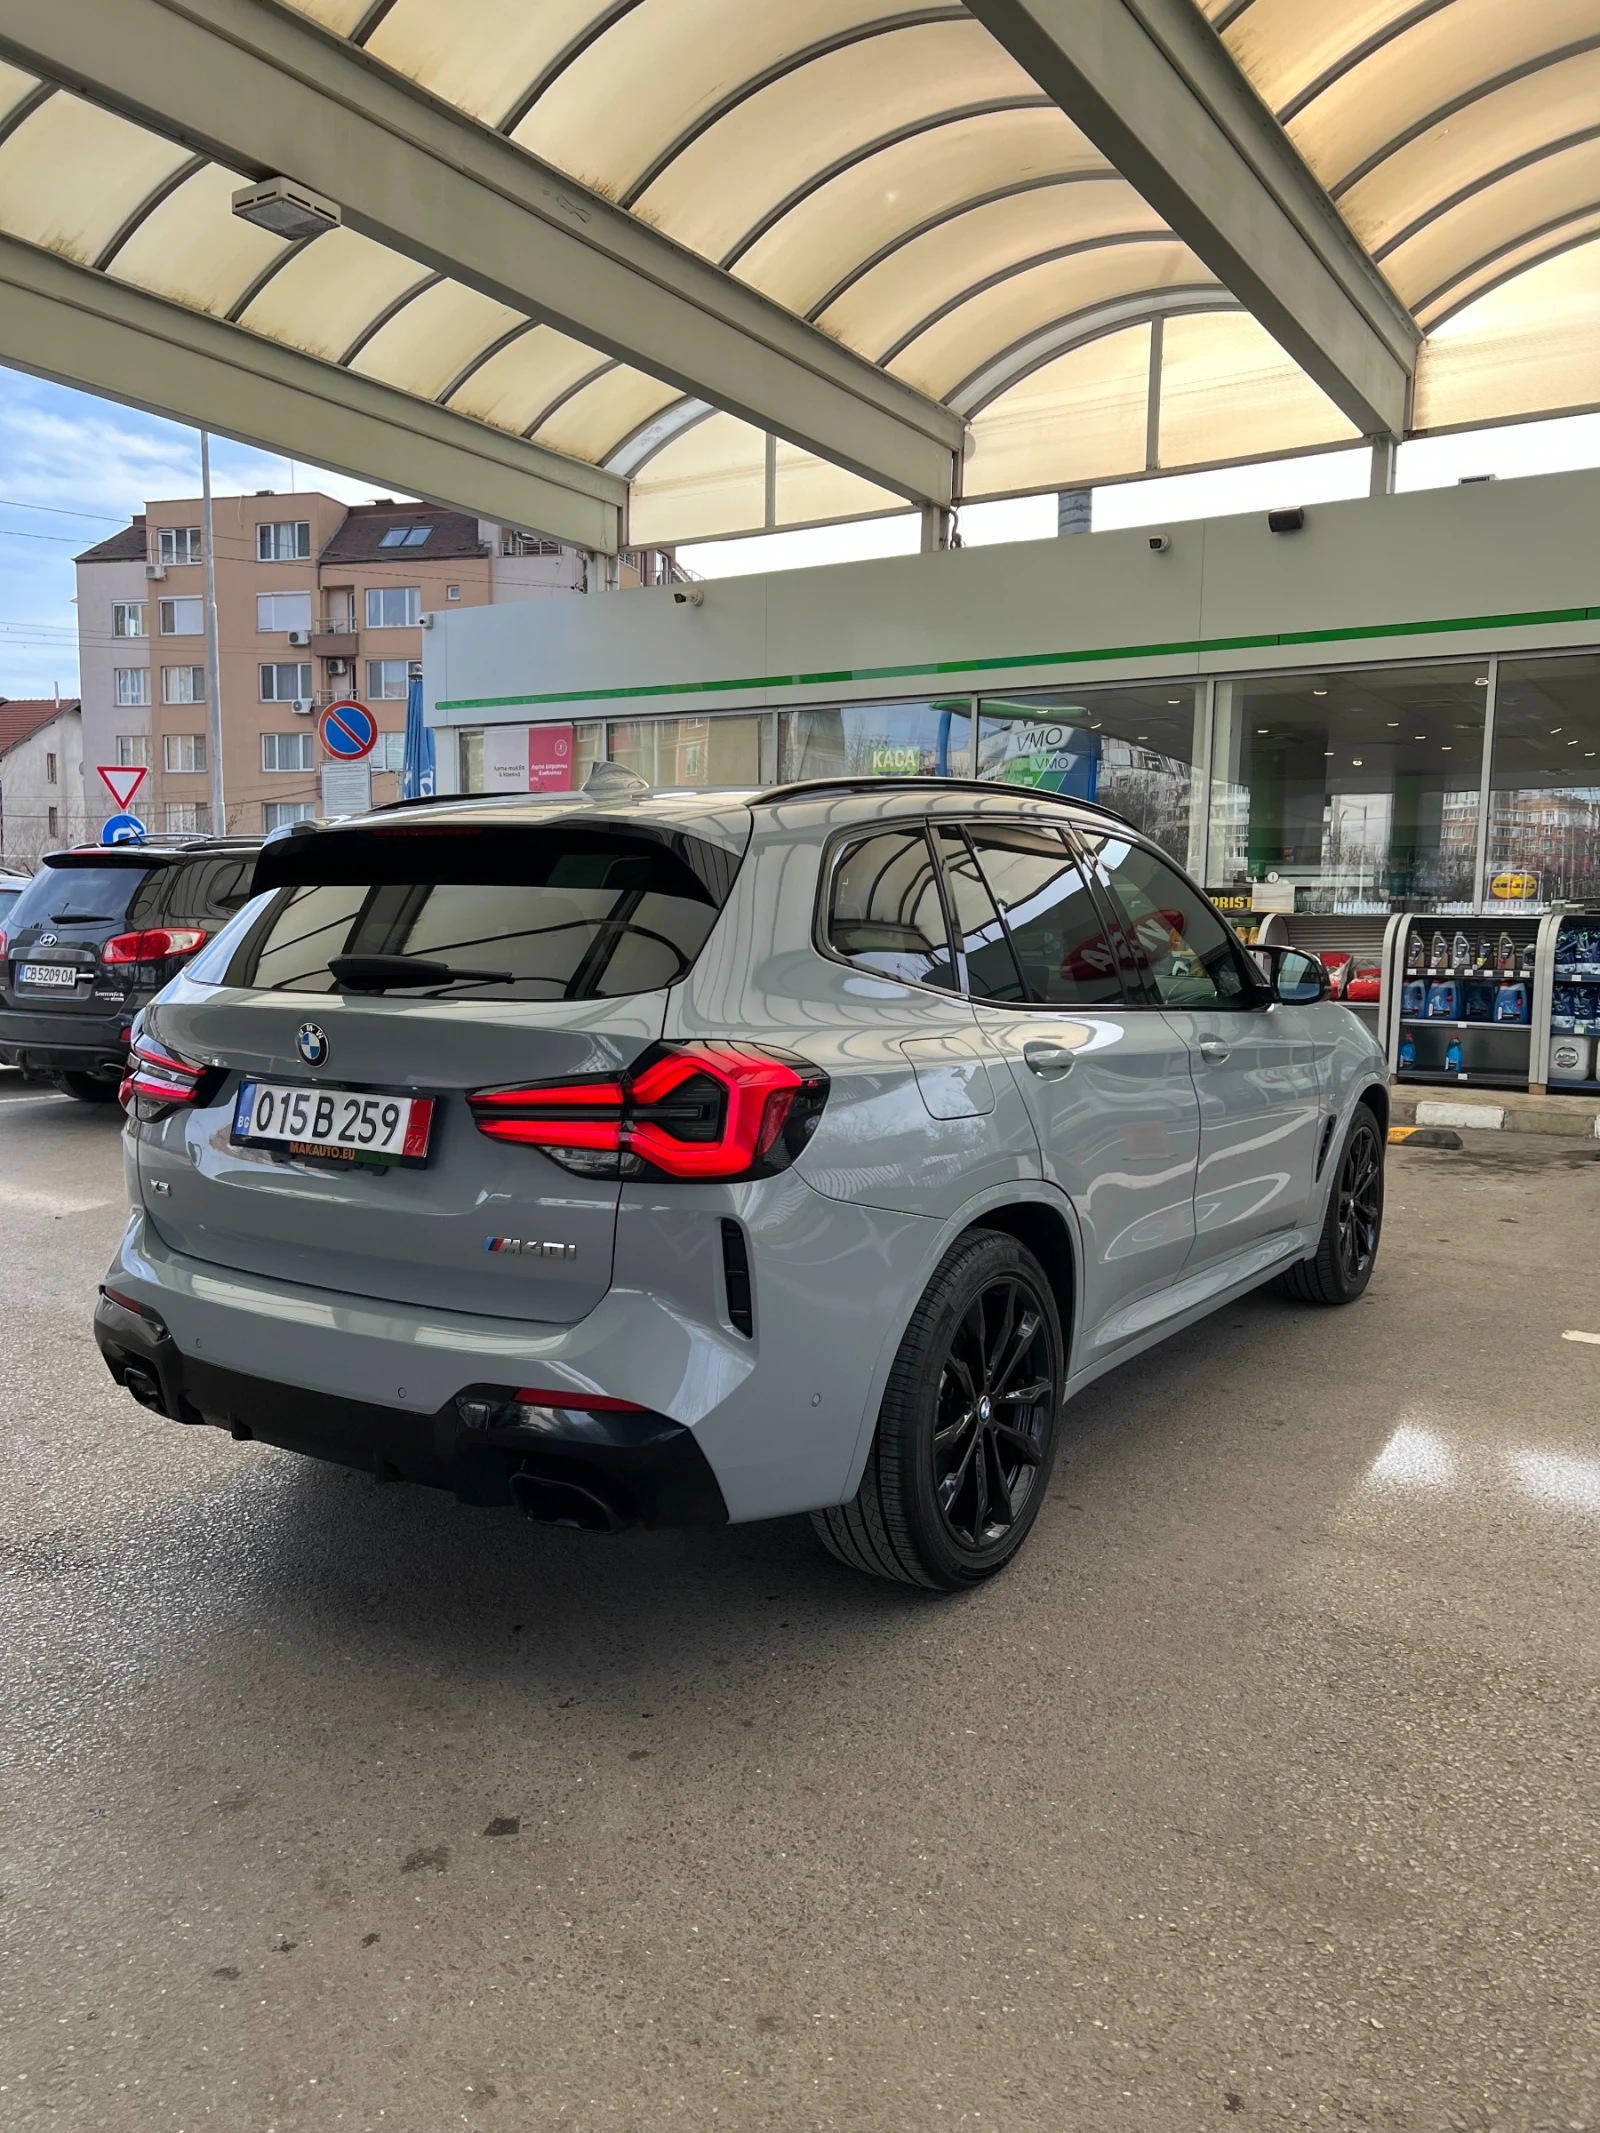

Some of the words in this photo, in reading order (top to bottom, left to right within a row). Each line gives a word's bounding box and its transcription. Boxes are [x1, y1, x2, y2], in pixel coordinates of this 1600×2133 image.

[872, 749, 917, 769] КАСА
[237, 1115, 250, 1129] BG
[256, 1090, 401, 1146] 015B259
[289, 1141, 356, 1161] MAKAUTO.EU
